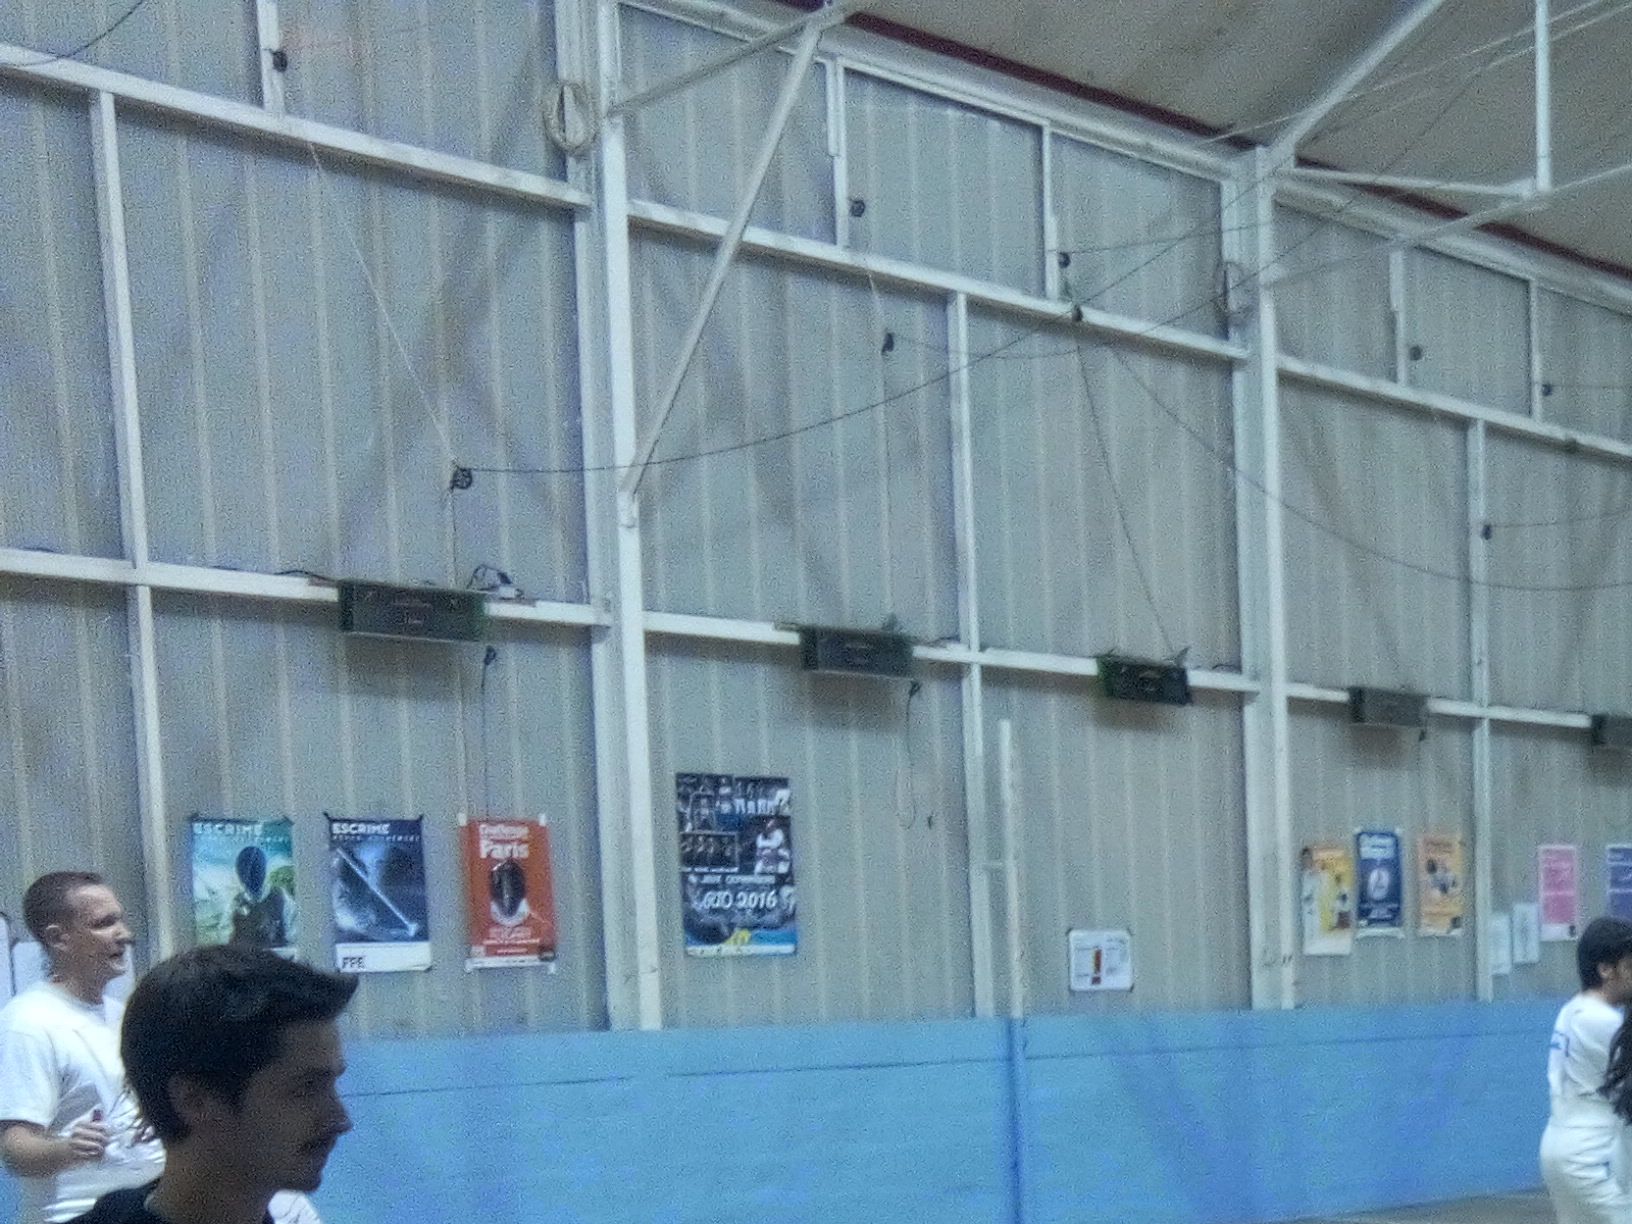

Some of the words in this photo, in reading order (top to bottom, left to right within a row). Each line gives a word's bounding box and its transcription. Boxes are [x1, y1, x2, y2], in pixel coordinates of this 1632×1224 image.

[332, 822, 390, 835] ESCRIME
[479, 840, 529, 858] Paris
[736, 888, 778, 909] 2016
